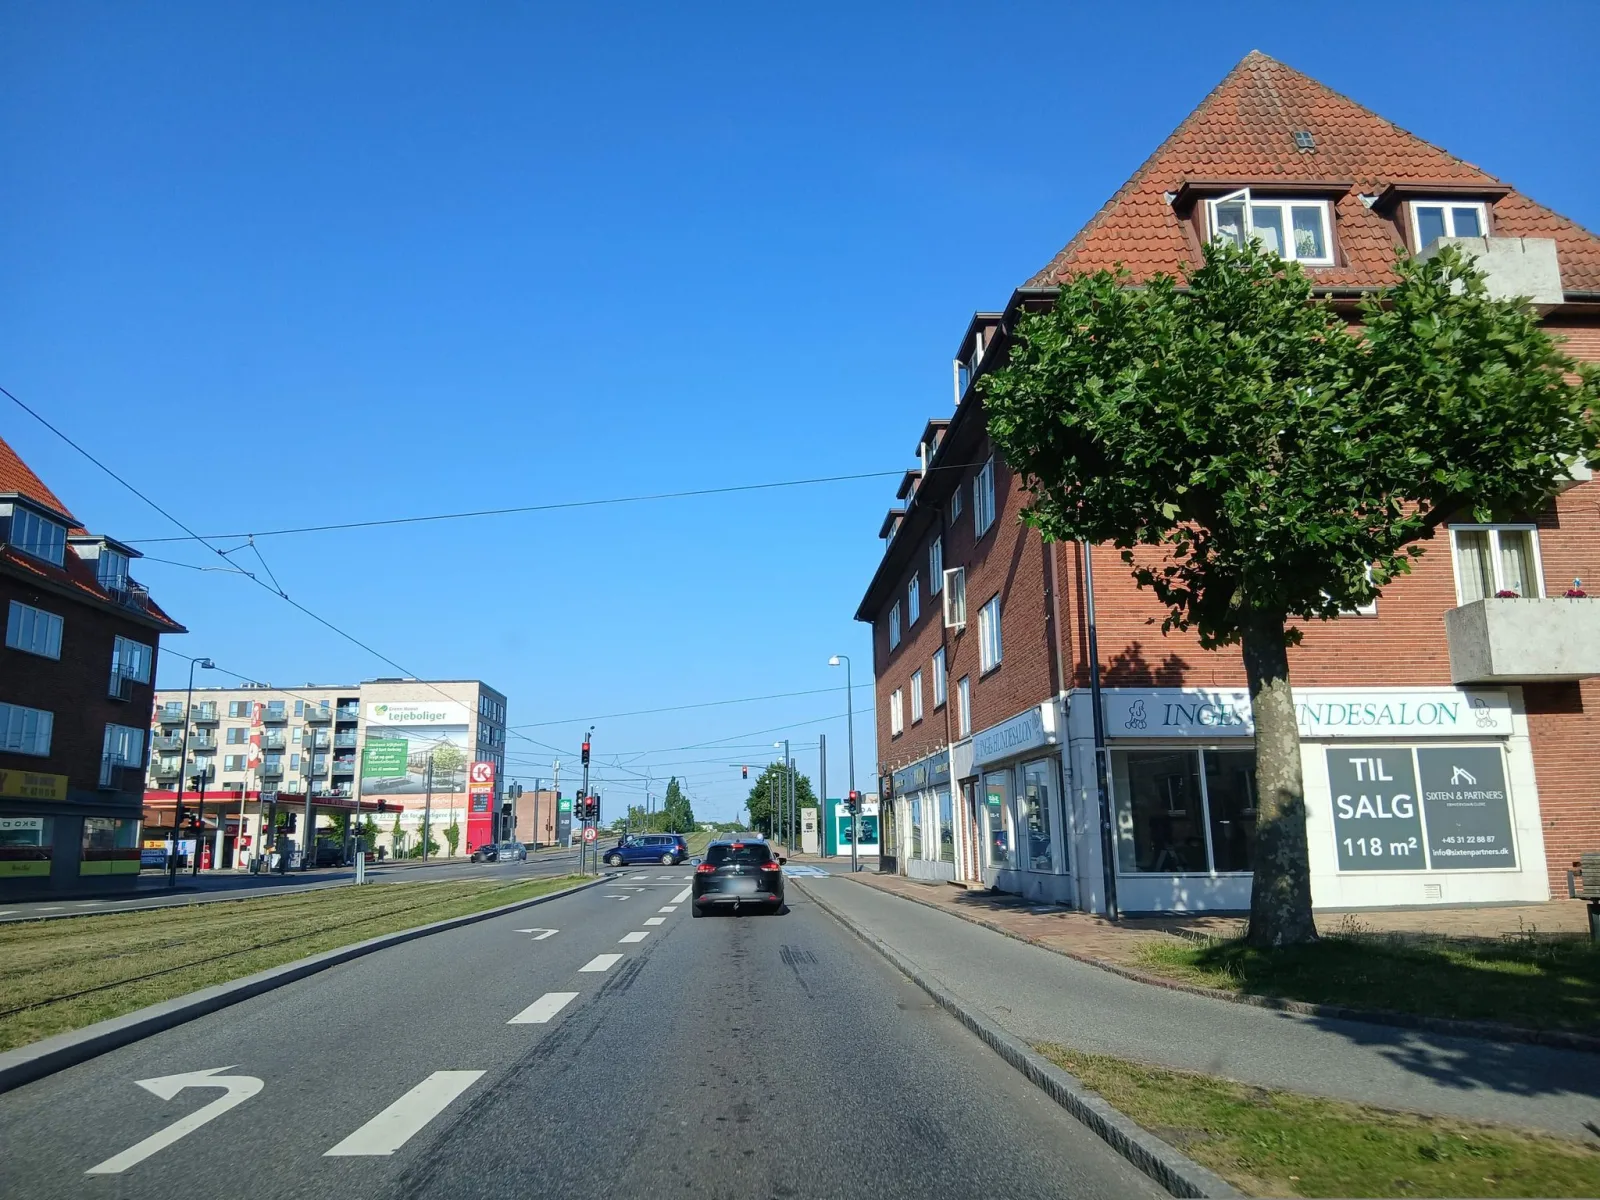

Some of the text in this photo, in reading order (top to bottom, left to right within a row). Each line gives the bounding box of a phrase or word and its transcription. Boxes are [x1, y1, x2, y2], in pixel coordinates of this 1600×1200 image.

[389, 711, 446, 722] Lejeboliger
[1296, 703, 1460, 726] NDESALON
[1349, 758, 1393, 781] TIL
[1426, 791, 1503, 801] SIXTEN & PARTNERS
[1337, 794, 1414, 819] SALG
[1343, 836, 1418, 857] 118 m²
[1441, 835, 1495, 844] +45 31 22 88 87
[1432, 847, 1509, 858] info@sixtenpartners.dk
